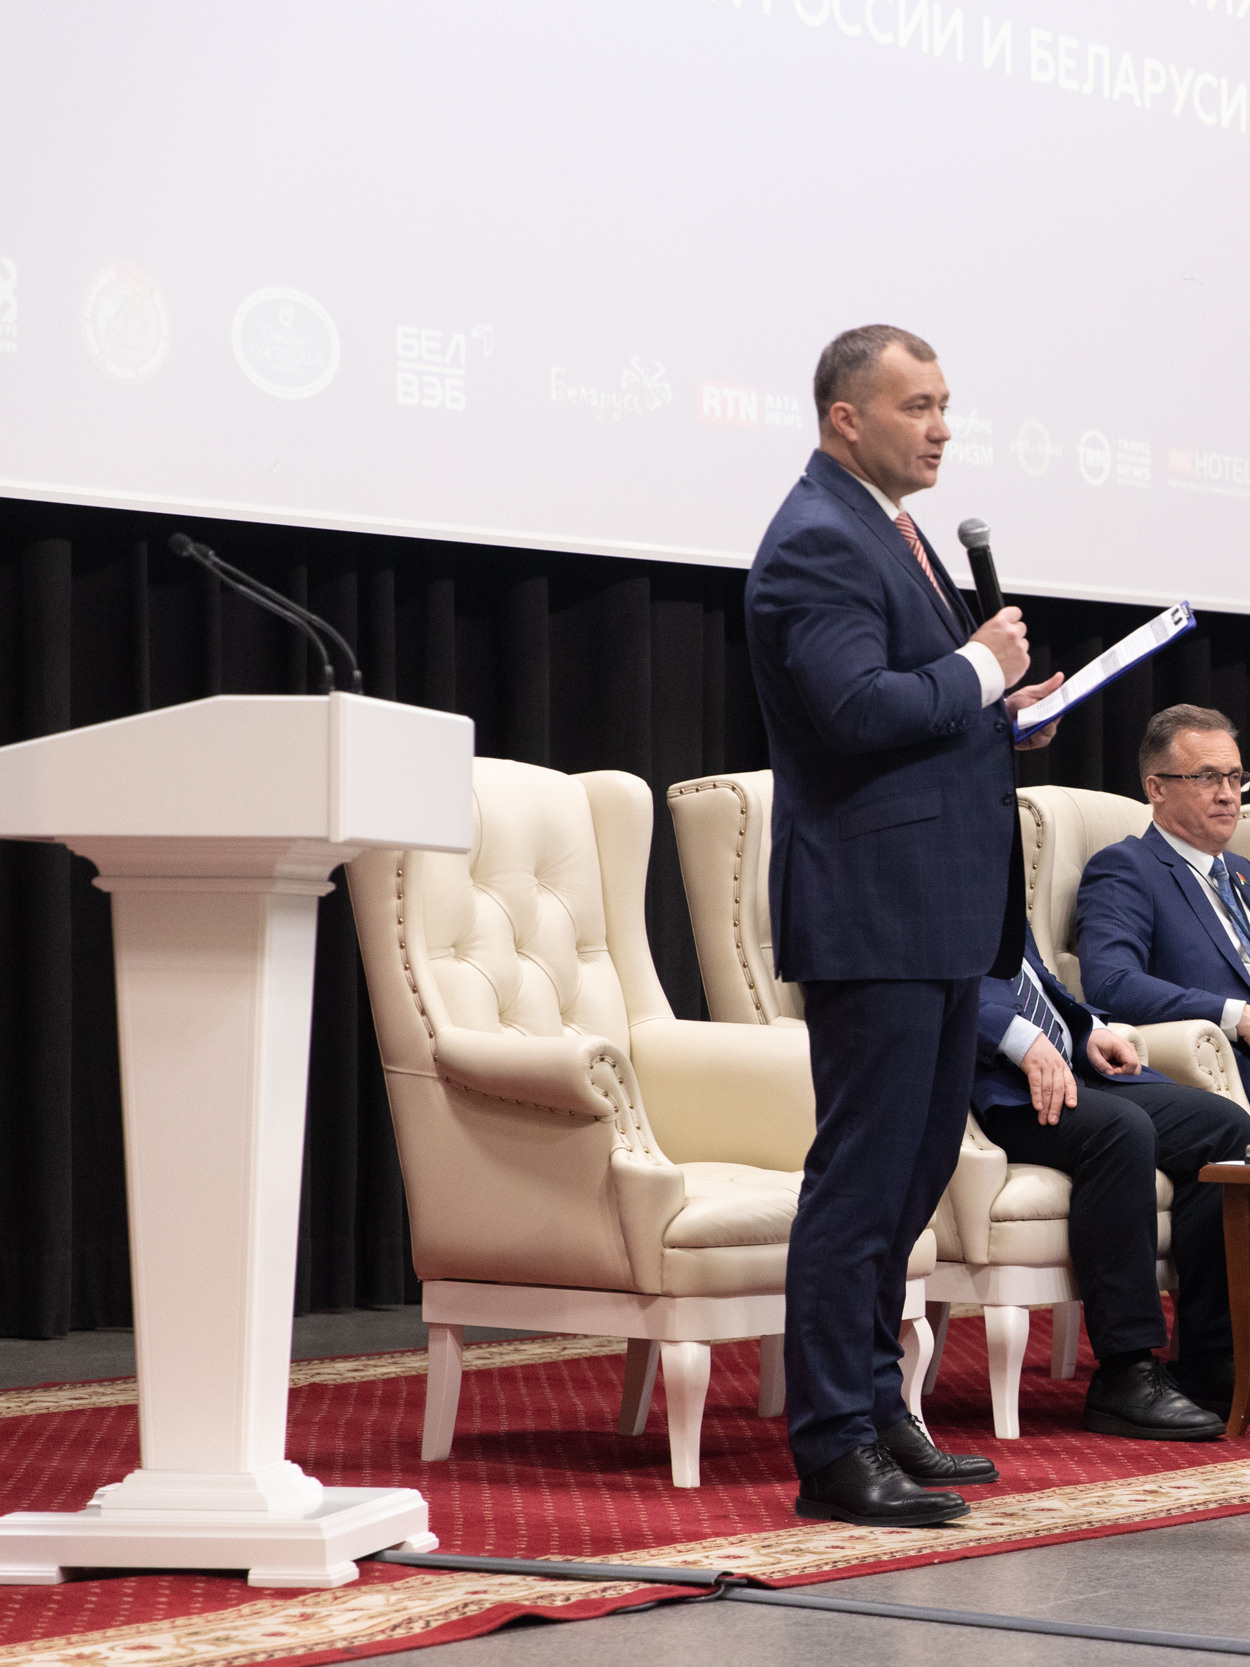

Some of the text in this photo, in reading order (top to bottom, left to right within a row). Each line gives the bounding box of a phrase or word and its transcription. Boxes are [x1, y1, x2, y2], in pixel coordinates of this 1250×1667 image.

[763, 0, 1247, 133] ССИИ И БЕЛАРУСИ
[396, 324, 467, 366] БЕЛ
[396, 371, 467, 411] ВЭБ
[702, 384, 758, 423] RTN
[766, 394, 799, 412] RATA
[766, 410, 802, 429] NEWS
[948, 441, 994, 467] РИЗМ
